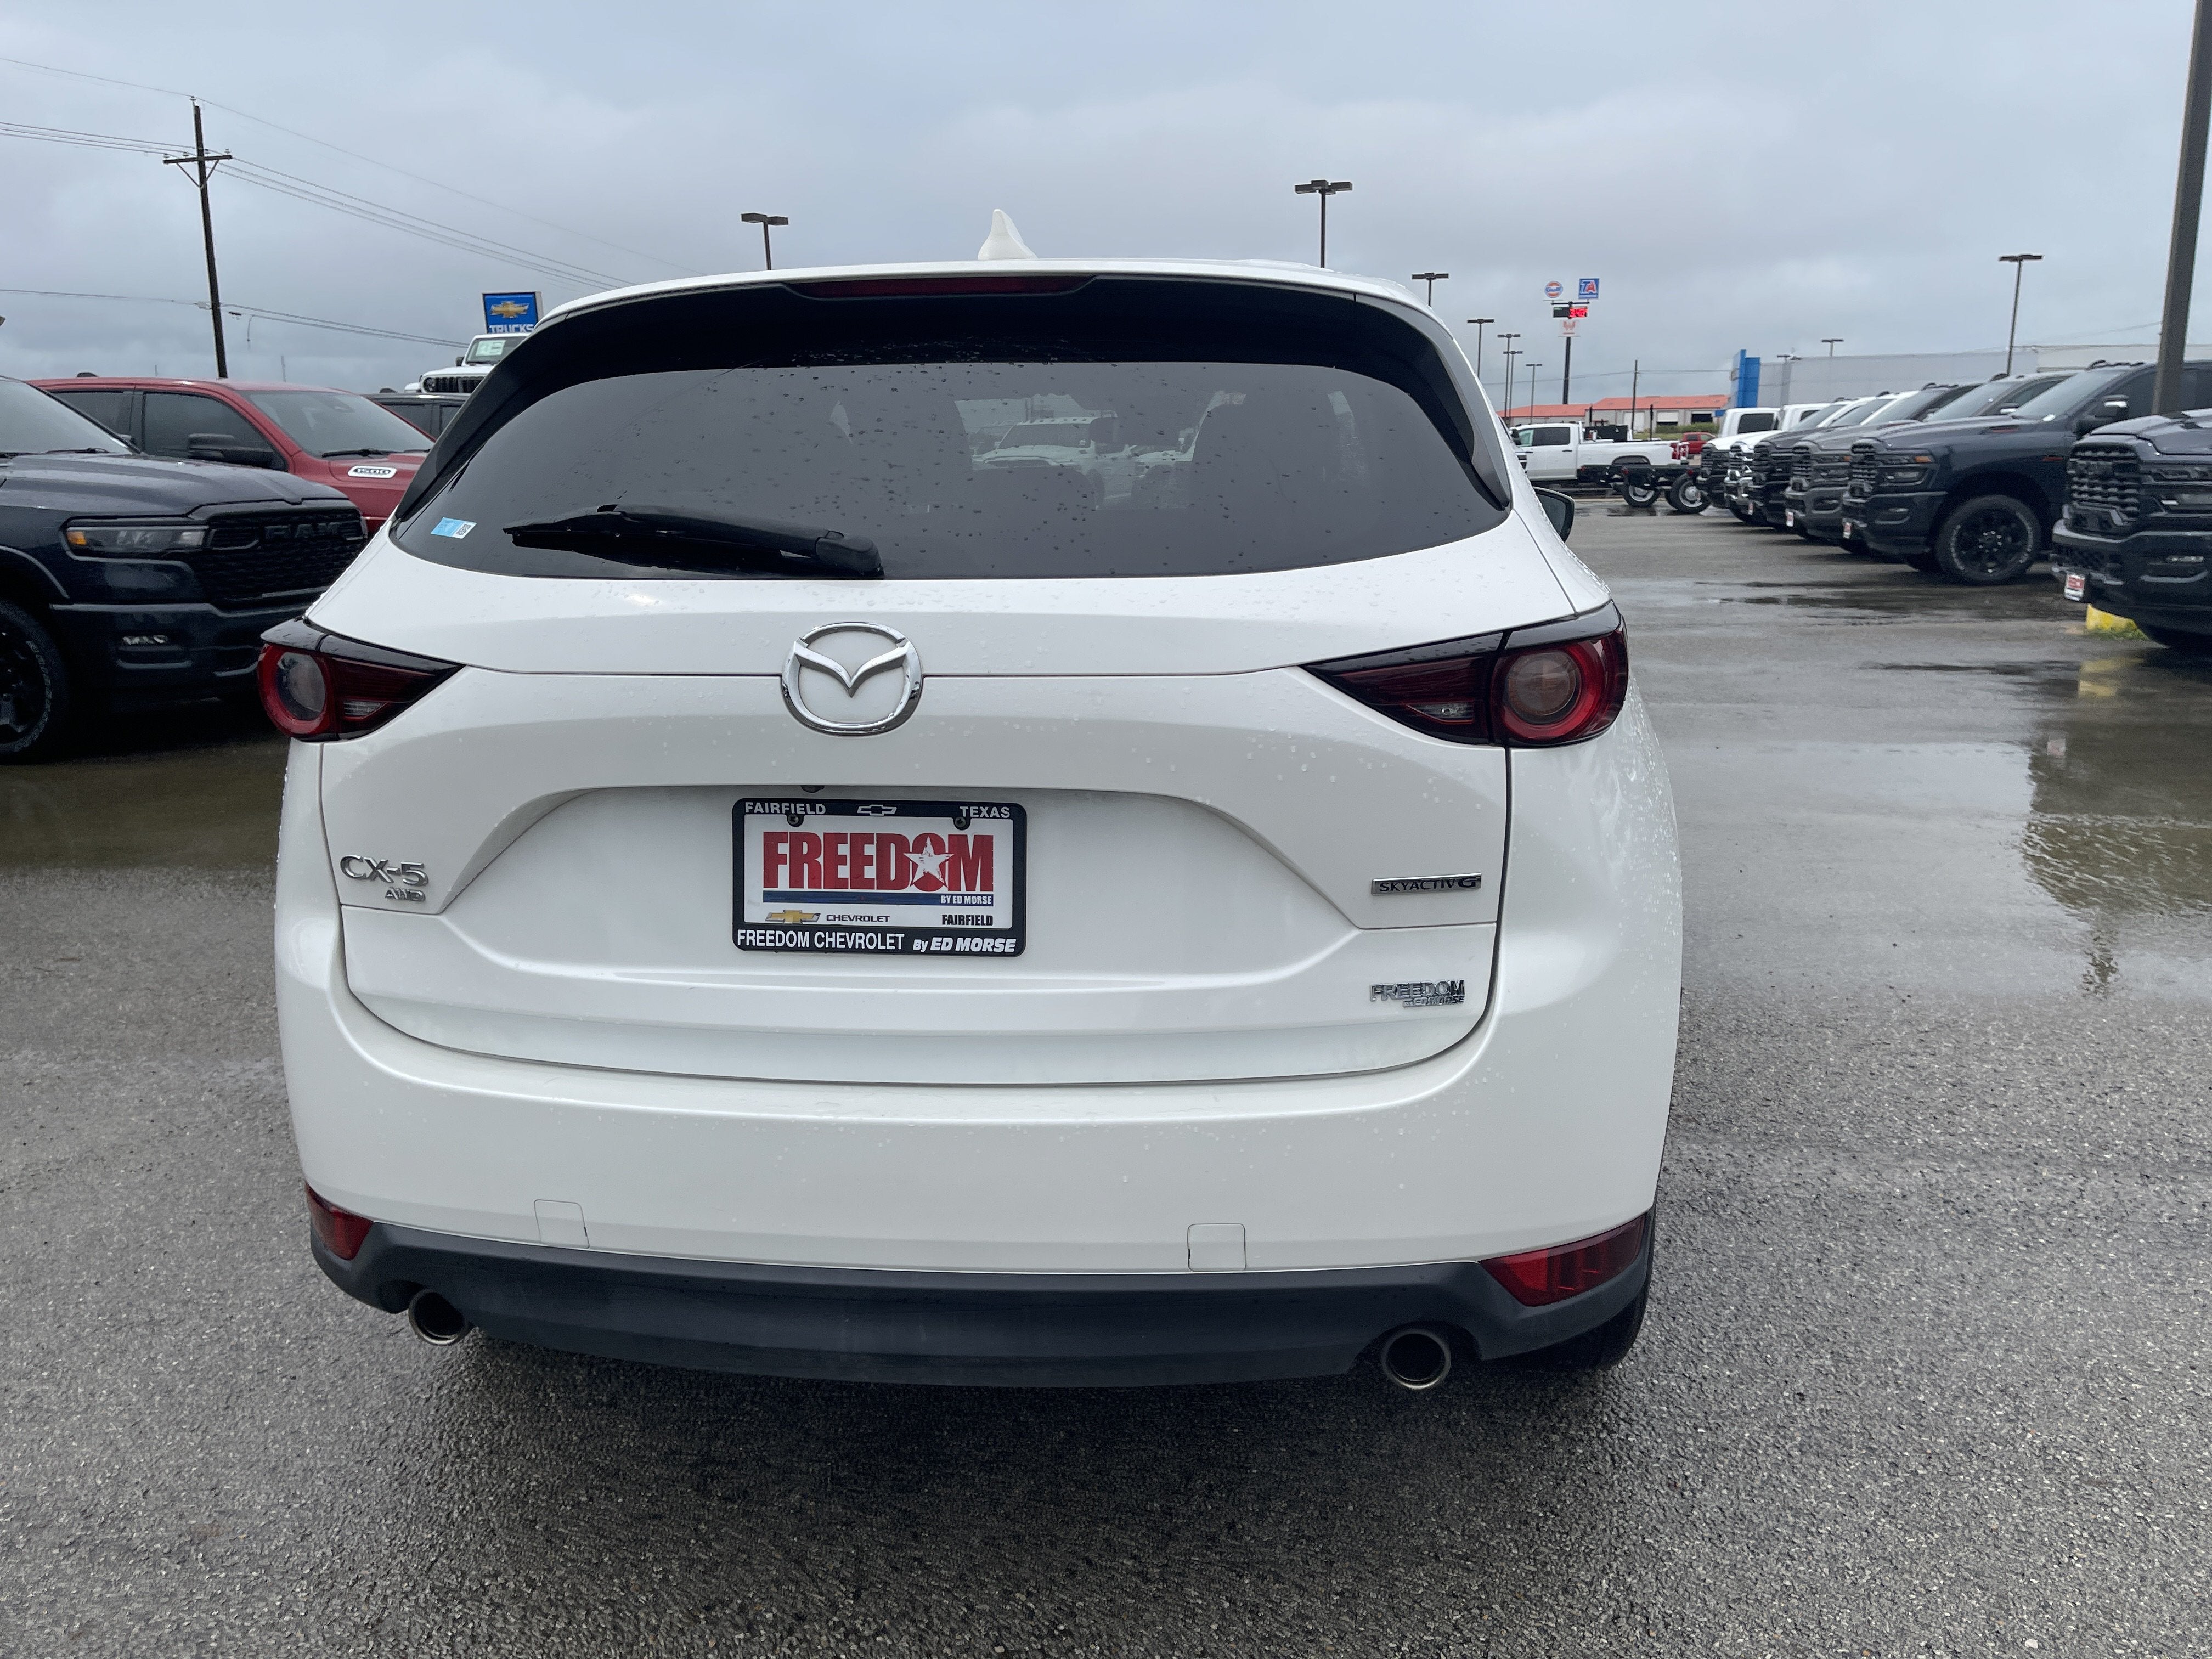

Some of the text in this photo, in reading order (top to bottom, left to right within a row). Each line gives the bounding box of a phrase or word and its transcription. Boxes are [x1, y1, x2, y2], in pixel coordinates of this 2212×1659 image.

[489, 324, 534, 333] TRUCKS
[744, 802, 1011, 819] FAIRFIELD TEXAS
[763, 831, 994, 892] FREEDOM
[340, 855, 429, 887] CX-5
[385, 887, 426, 901] AWD
[940, 895, 992, 905] BY ED MORSE
[826, 914, 890, 923] CHEVROLET
[941, 914, 994, 926] FAIRFIELD
[737, 929, 1017, 952] FREEDOM CHEVROLET By ED MORSE
[1370, 979, 1465, 1002] FREEDOM
